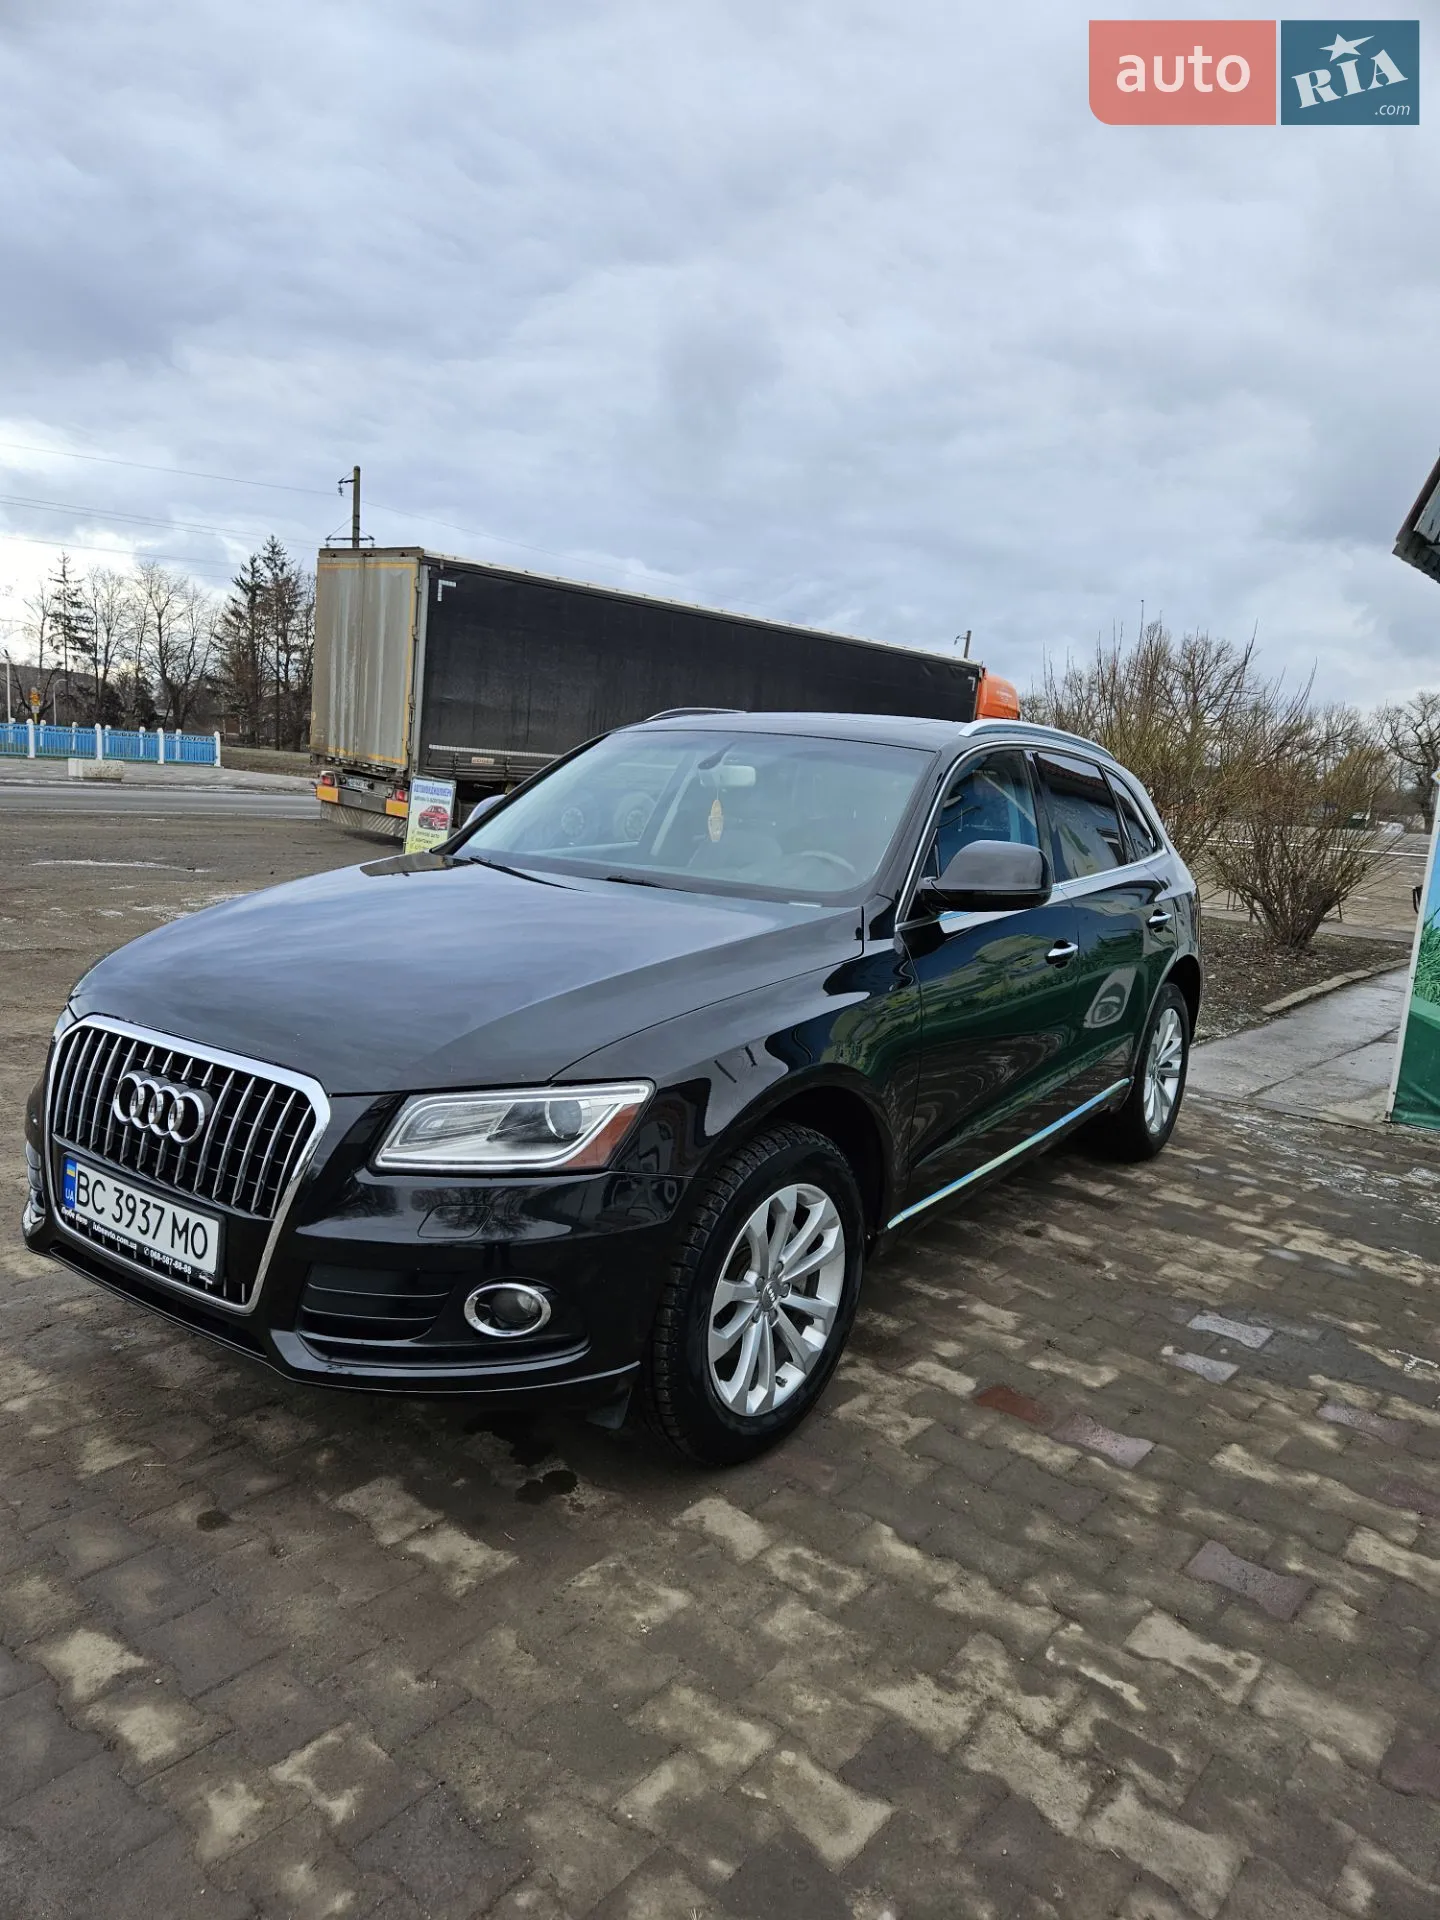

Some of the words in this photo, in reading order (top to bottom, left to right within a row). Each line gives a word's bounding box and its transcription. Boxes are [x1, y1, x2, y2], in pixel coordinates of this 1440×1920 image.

[65, 1187, 75, 1203] UA
[76, 1170, 106, 1215] BC
[111, 1186, 165, 1240] 3937
[171, 1211, 208, 1260] MO
